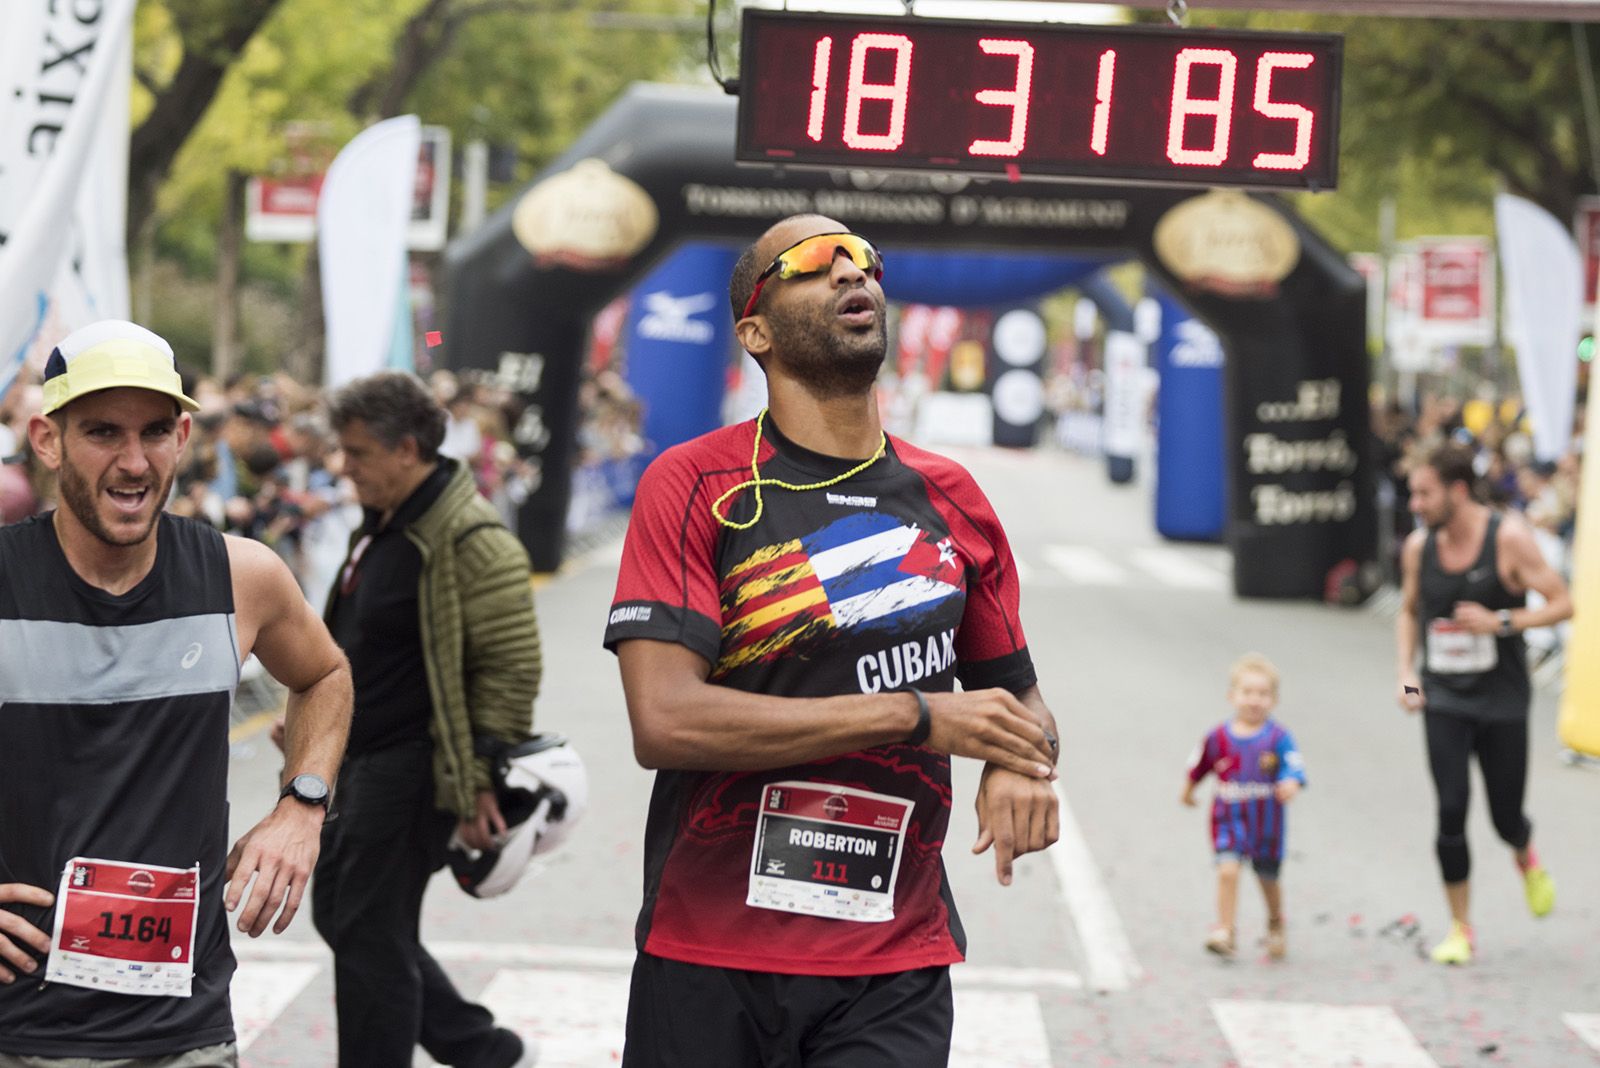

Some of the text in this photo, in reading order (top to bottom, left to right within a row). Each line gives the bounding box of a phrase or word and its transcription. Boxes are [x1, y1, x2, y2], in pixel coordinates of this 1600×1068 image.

[807, 33, 913, 151] 18
[1166, 48, 1315, 170] 85
[857, 628, 957, 694] CUBAN
[789, 828, 876, 857] ROBERTON
[812, 860, 849, 883] 111
[97, 911, 171, 944] 1164
